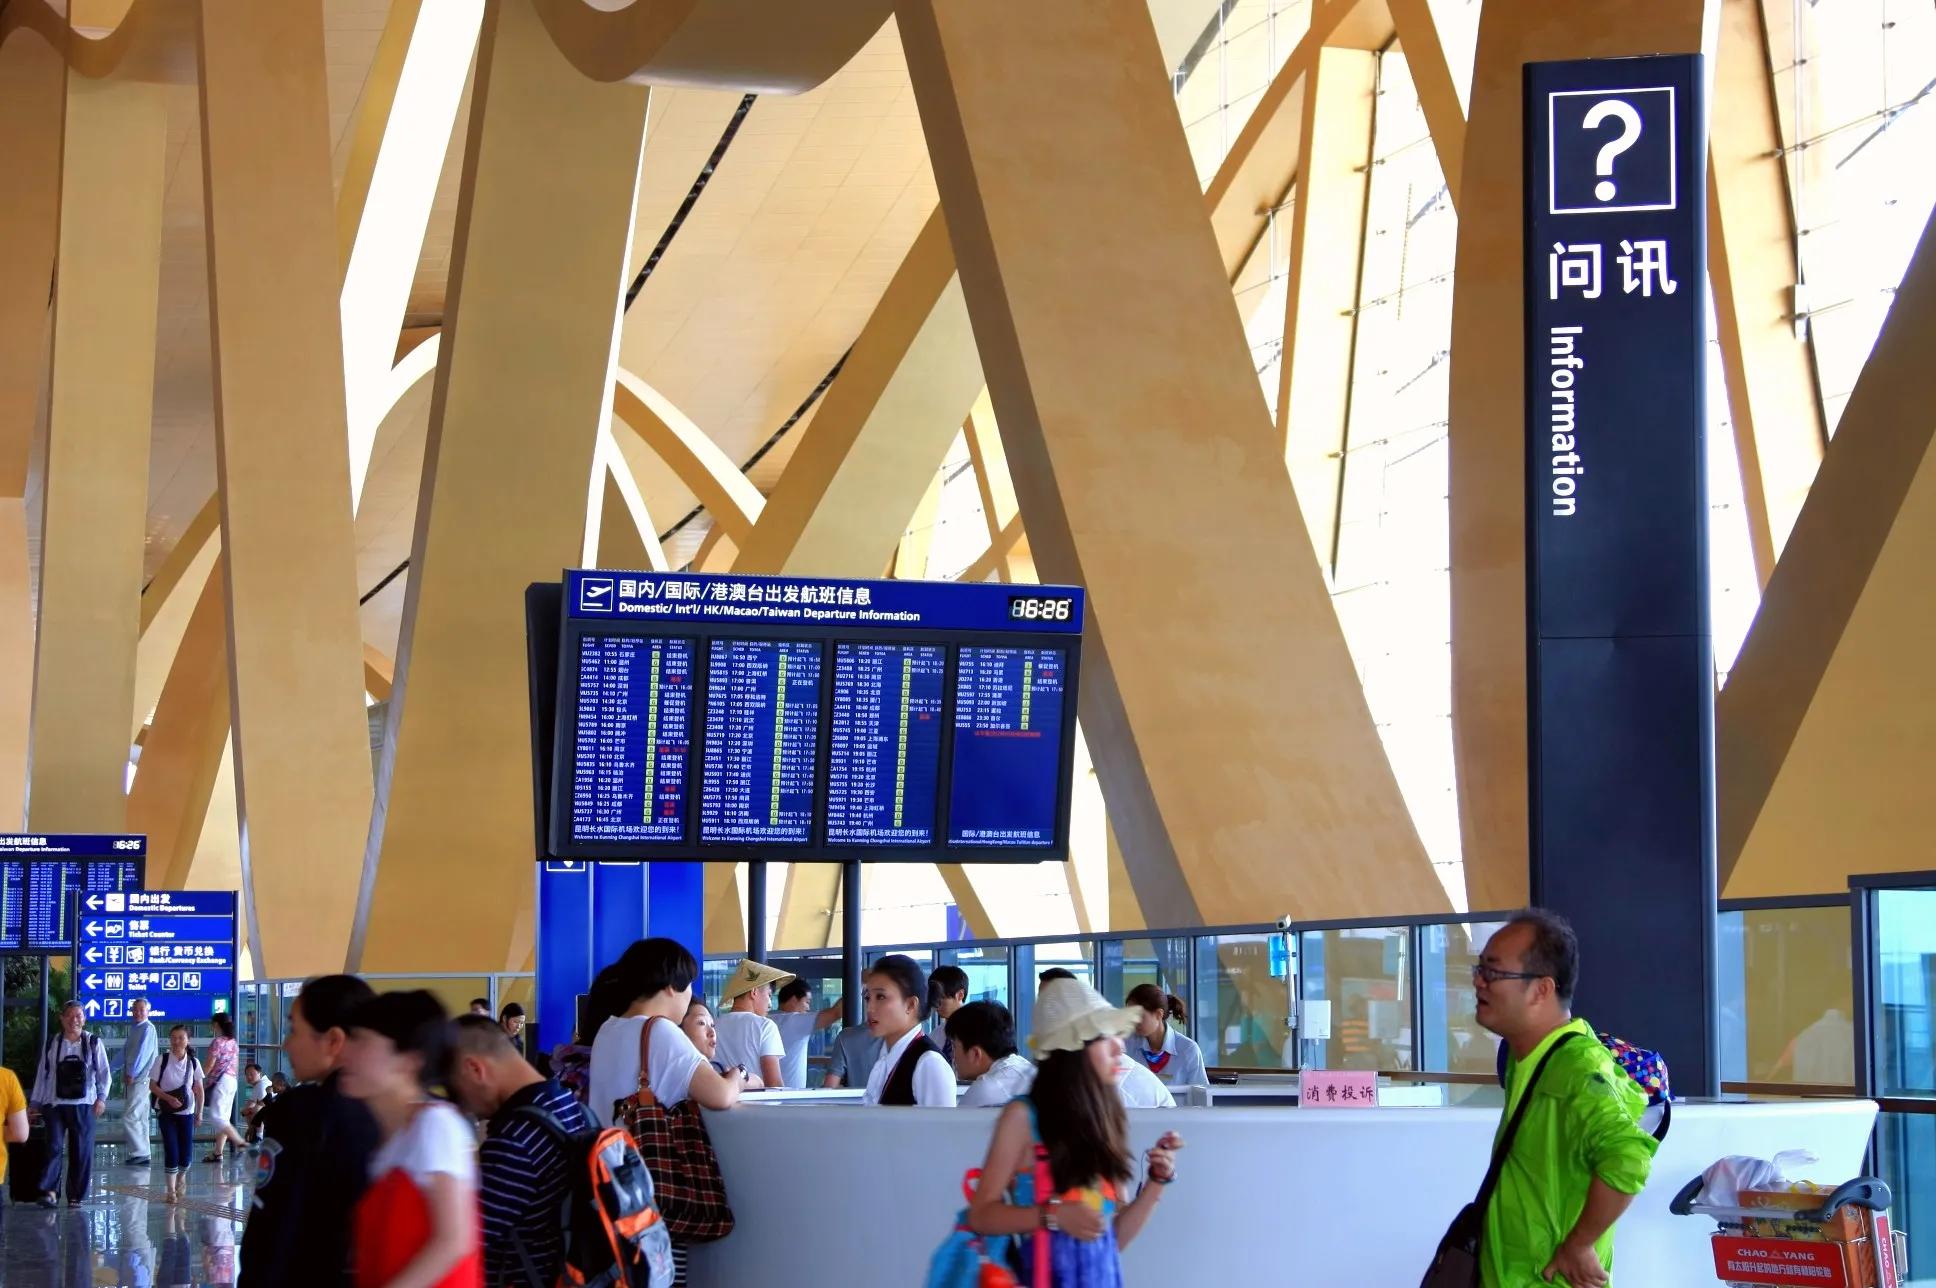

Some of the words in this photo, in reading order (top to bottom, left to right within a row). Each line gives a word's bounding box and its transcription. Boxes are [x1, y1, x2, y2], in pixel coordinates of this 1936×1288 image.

[1550, 240, 1678, 300] 问讯
[1550, 326, 1584, 516] Information
[619, 579, 872, 605] 国内/国际/港澳台出发航班信息
[618, 602, 673, 614] Domestic/
[675, 604, 702, 615] Int'l/
[703, 605, 801, 618] HK/Macao/Taiwan
[803, 608, 857, 620] Departure
[859, 610, 921, 621] Information
[1014, 599, 1069, 619] 16:26
[667, 834, 682, 842] Airport
[918, 838, 930, 846] Airport
[1307, 1084, 1374, 1102] 消费投诉
[1737, 1249, 1768, 1257] CHAO
[1783, 1252, 1815, 1260] YANG
